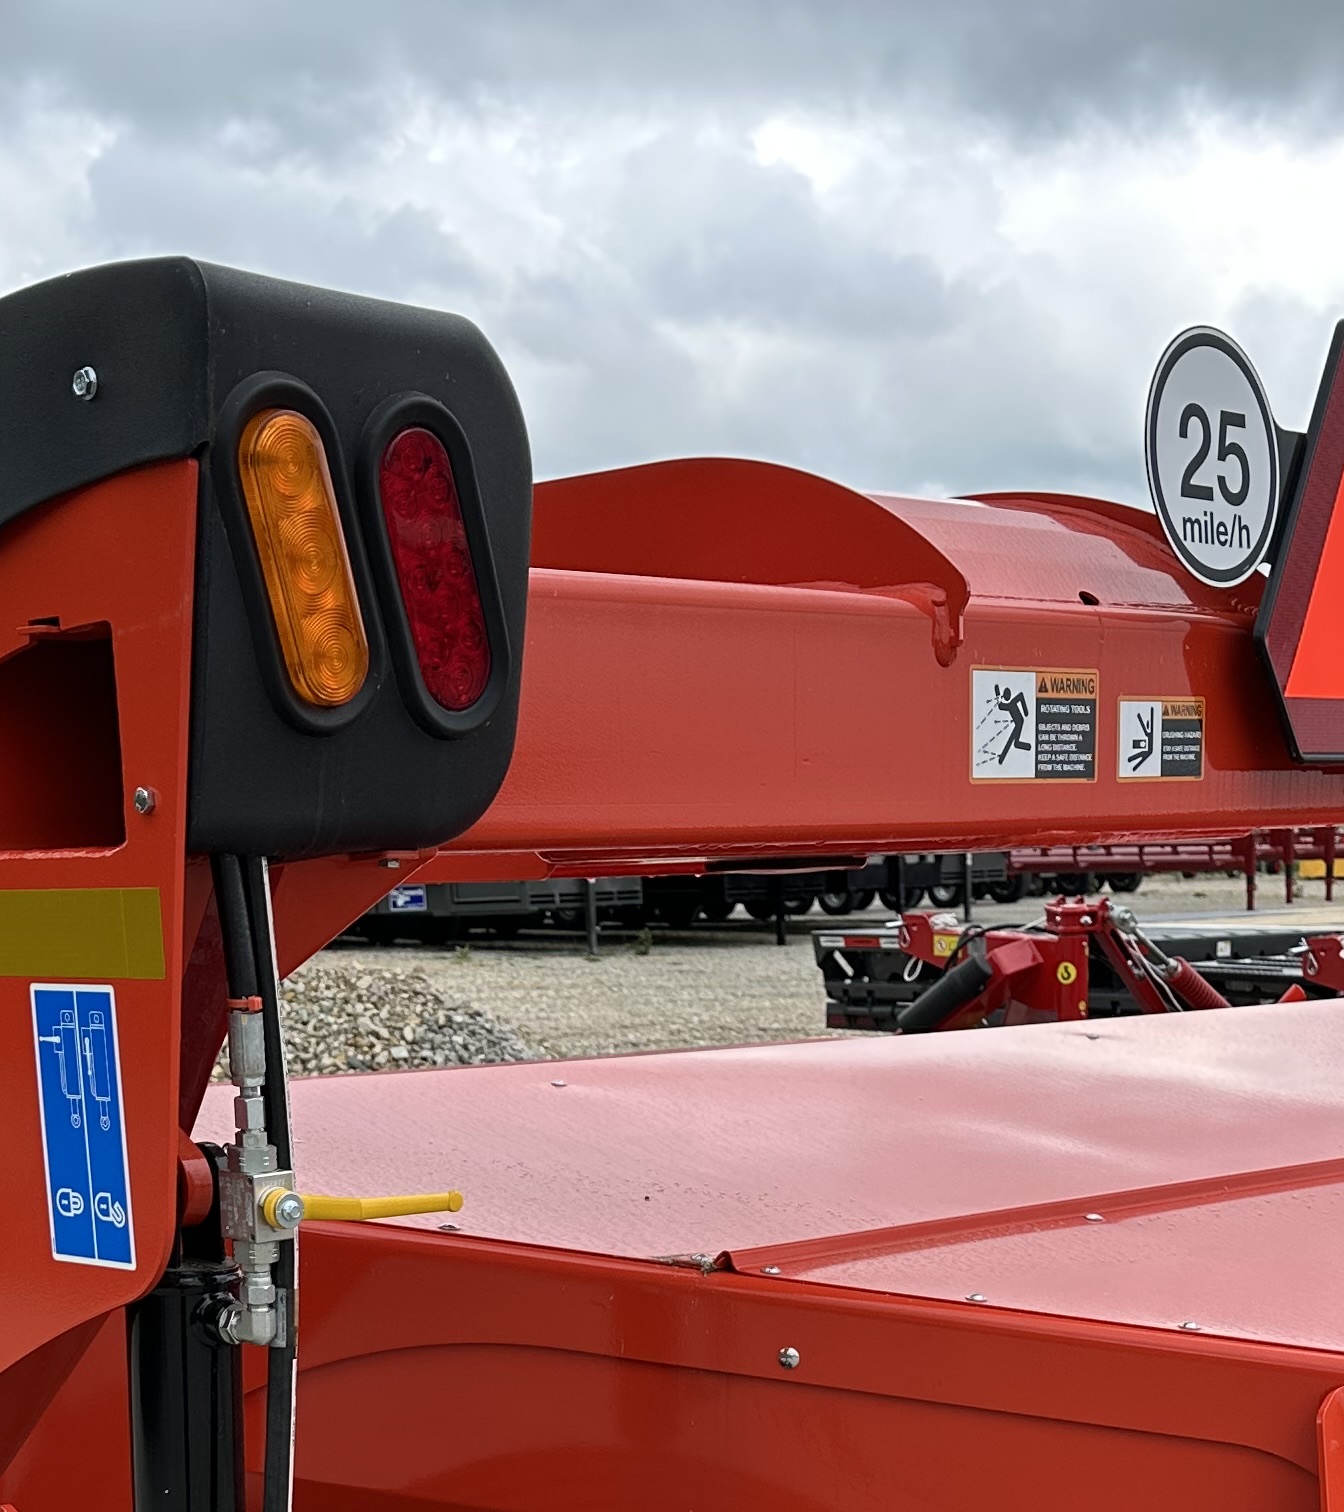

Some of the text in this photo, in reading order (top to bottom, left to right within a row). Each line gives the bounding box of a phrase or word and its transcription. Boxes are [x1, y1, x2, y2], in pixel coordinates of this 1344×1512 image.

[1179, 402, 1251, 507] 25
[1181, 510, 1251, 549] mile/h
[1050, 676, 1095, 694] WARNING
[1040, 704, 1091, 714] ROTATING TOOLS
[1169, 703, 1203, 717] WARNING
